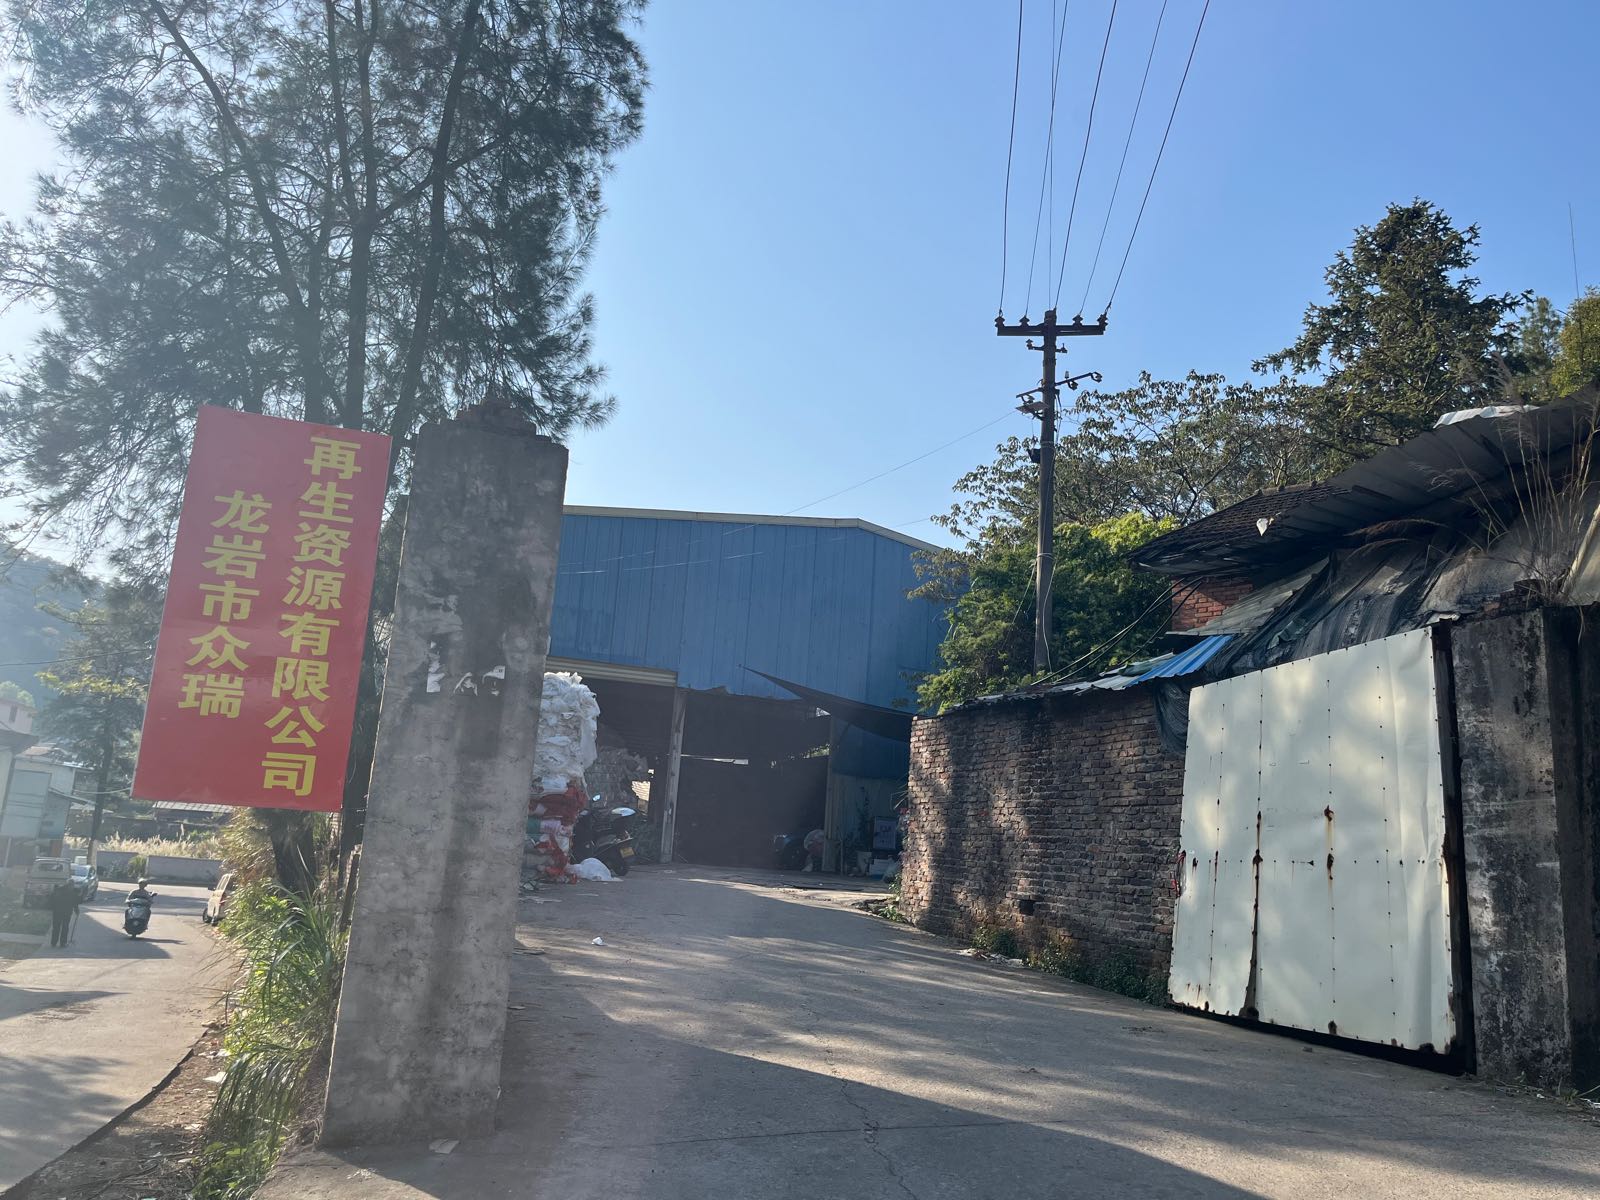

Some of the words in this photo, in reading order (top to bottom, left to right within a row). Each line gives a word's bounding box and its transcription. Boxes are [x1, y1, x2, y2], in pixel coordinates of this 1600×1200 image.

[178, 490, 272, 719] 龙岩市众瑞
[261, 437, 361, 796] 再生资源有限公司
